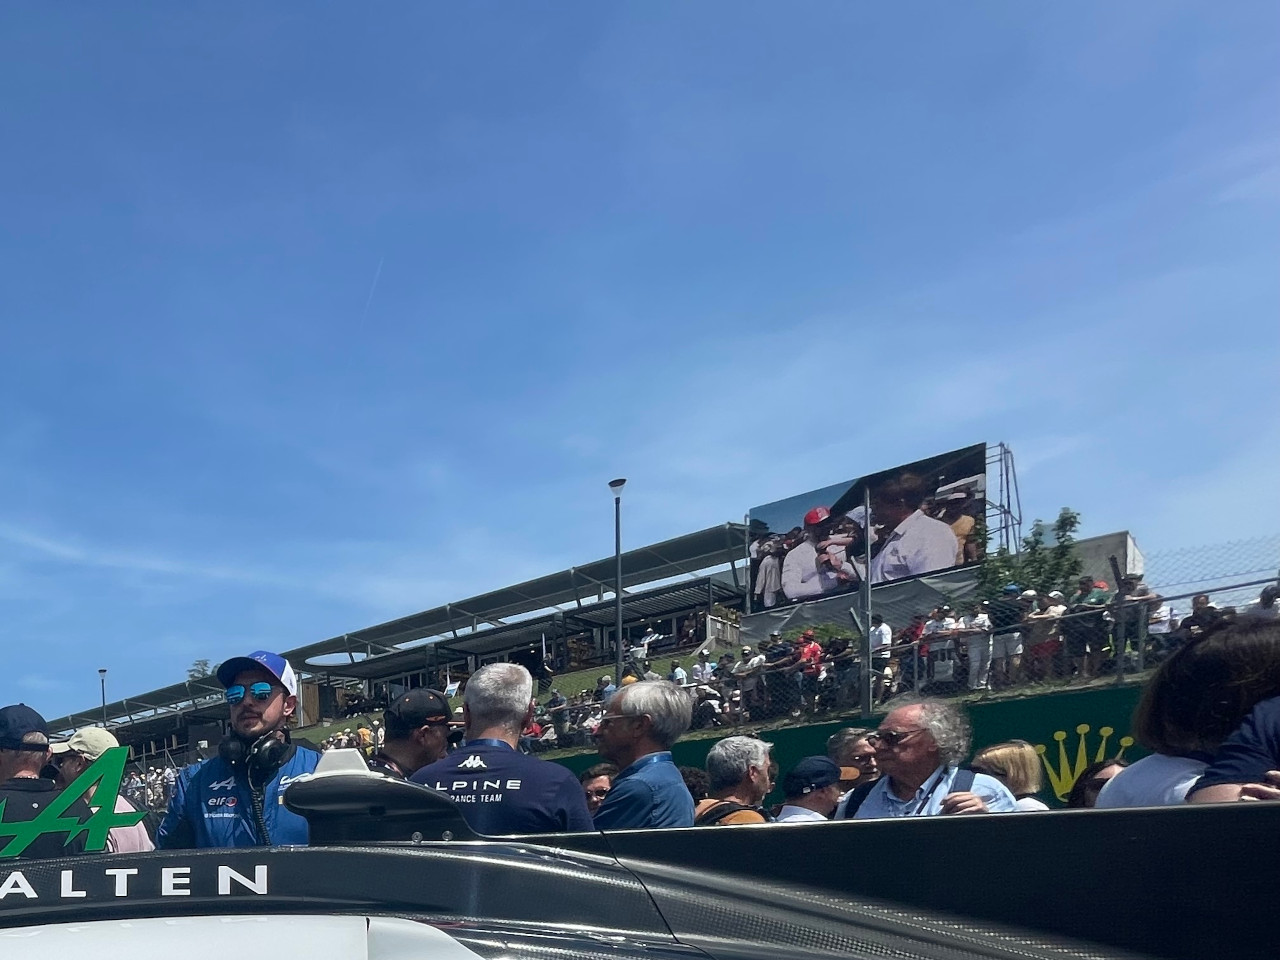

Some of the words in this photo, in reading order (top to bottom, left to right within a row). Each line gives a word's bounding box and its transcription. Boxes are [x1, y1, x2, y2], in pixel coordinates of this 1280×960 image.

[424, 779, 522, 791] LPINE
[208, 797, 226, 806] elf
[480, 793, 503, 803] TEAM
